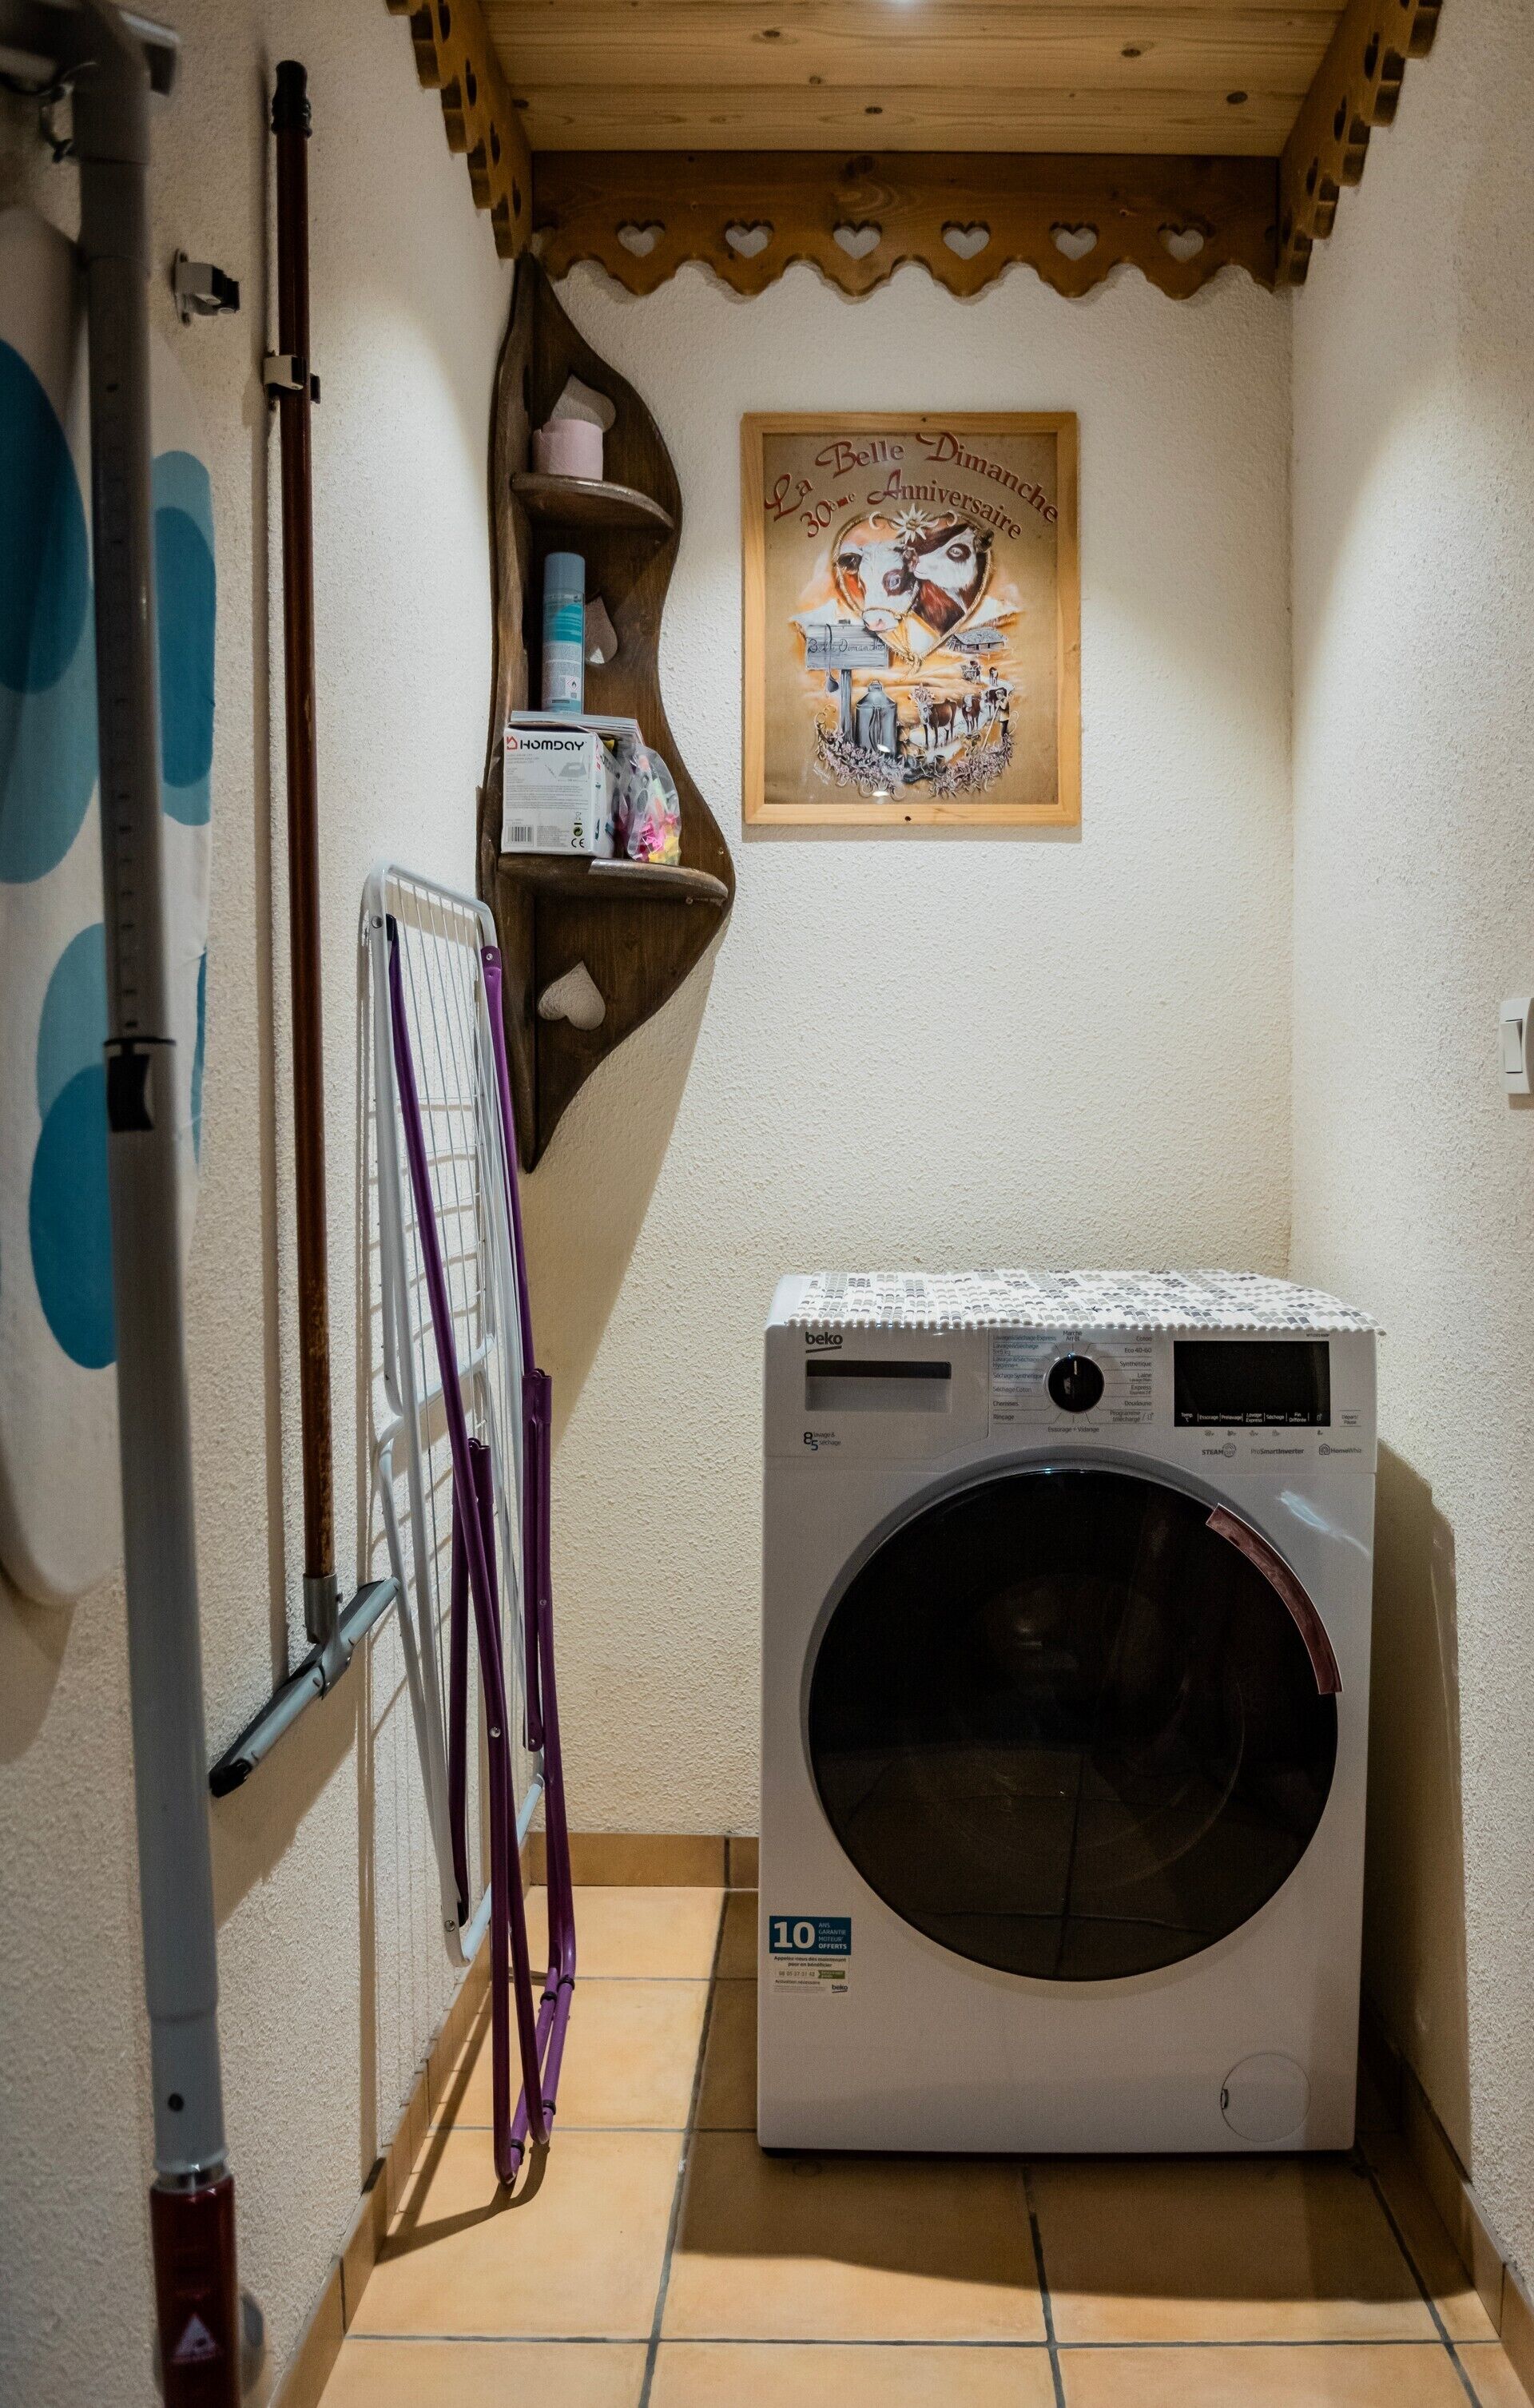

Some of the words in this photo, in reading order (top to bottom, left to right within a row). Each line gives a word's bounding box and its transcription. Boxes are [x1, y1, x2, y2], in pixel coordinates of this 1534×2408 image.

[764, 473, 813, 523] La
[814, 439, 905, 479] Belle
[915, 431, 1059, 524] Dimanche
[867, 468, 1023, 540] Anniversaire
[805, 1331, 844, 1345] beko
[803, 1432, 813, 1444] 8
[810, 1440, 819, 1451] 5
[773, 1921, 816, 1949] 10
